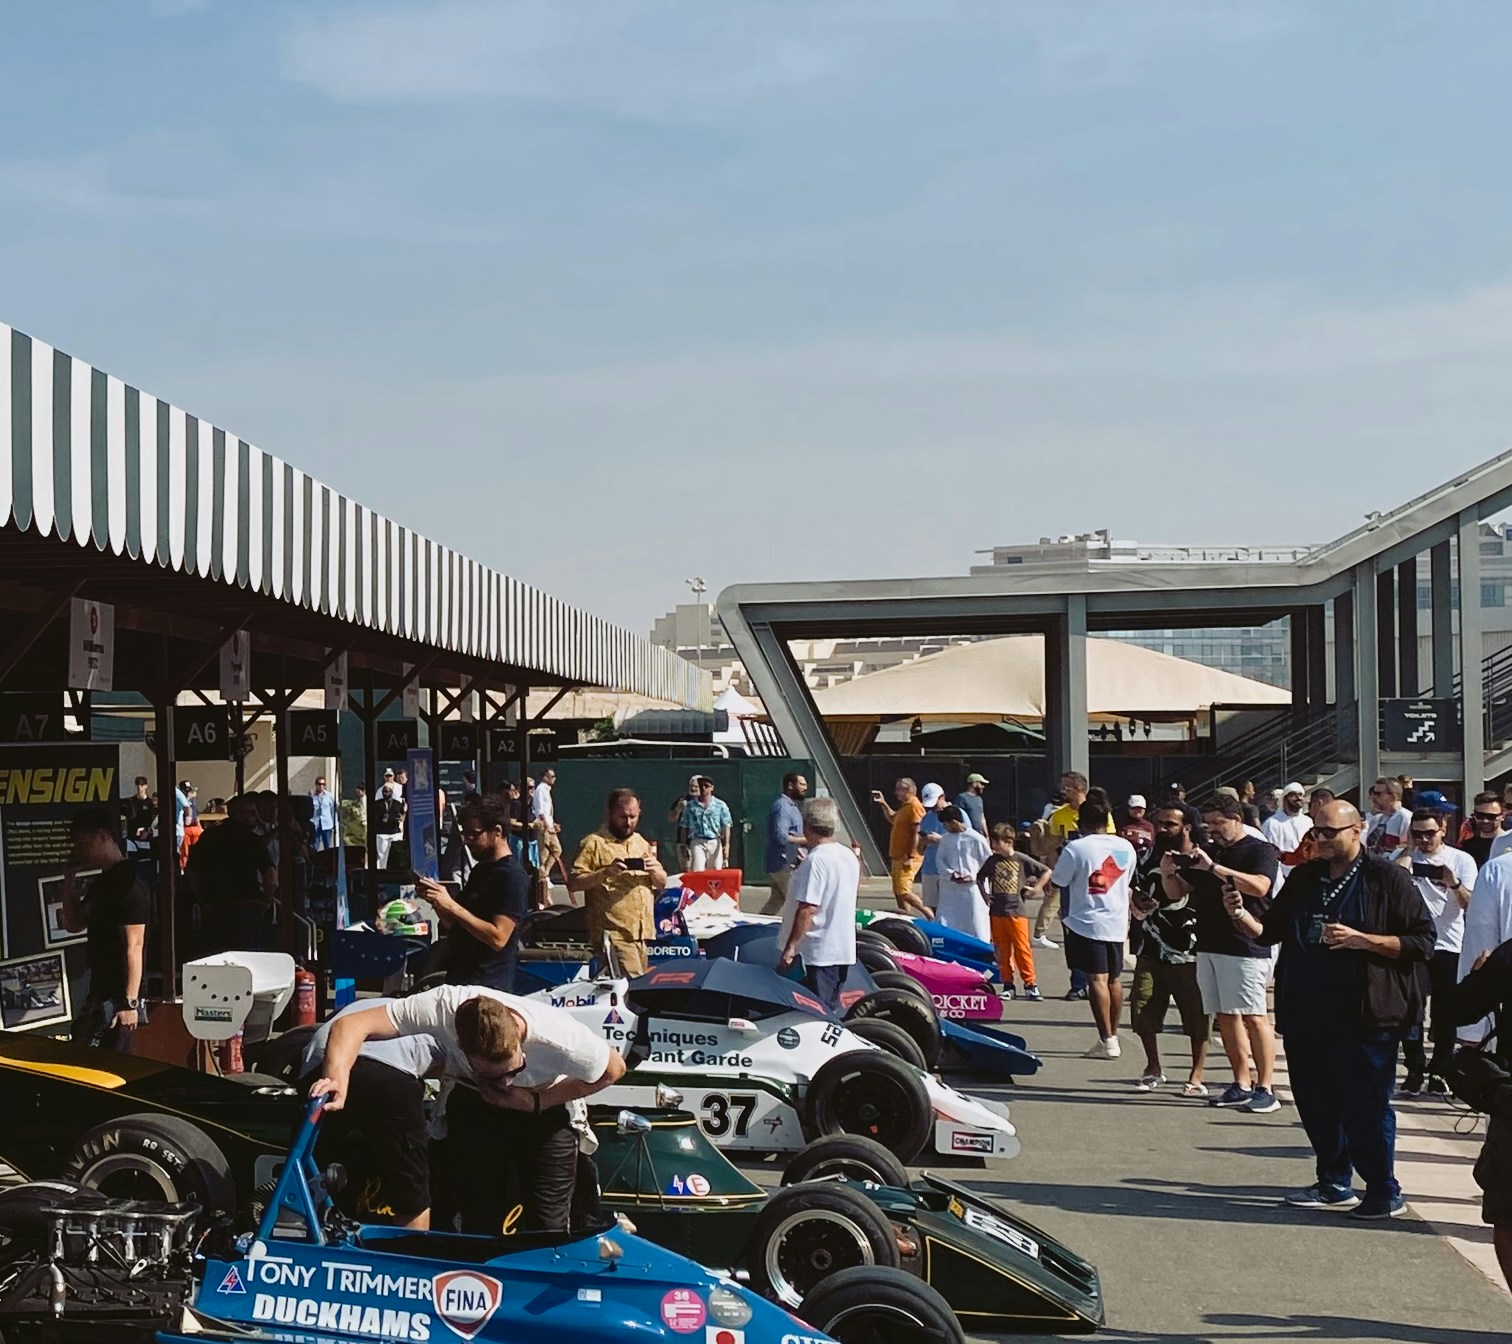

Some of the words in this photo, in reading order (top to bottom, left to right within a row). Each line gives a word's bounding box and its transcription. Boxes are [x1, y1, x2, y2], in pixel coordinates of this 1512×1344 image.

[13, 714, 49, 741] A7
[187, 721, 217, 744] A6
[302, 723, 327, 743] A5
[387, 732, 409, 749] A4
[450, 736, 470, 751] A3
[497, 739, 516, 753] A2
[537, 742, 553, 754] A1
[551, 994, 596, 1008] Mobil
[602, 1025, 719, 1047] Tecniques
[691, 1050, 753, 1068] Garde
[700, 1091, 759, 1139] 37
[244, 1255, 317, 1288] TONY
[321, 1260, 433, 1302] TRIMMER
[445, 1288, 487, 1313] FINA
[251, 1293, 431, 1341] DUCKHAMS
